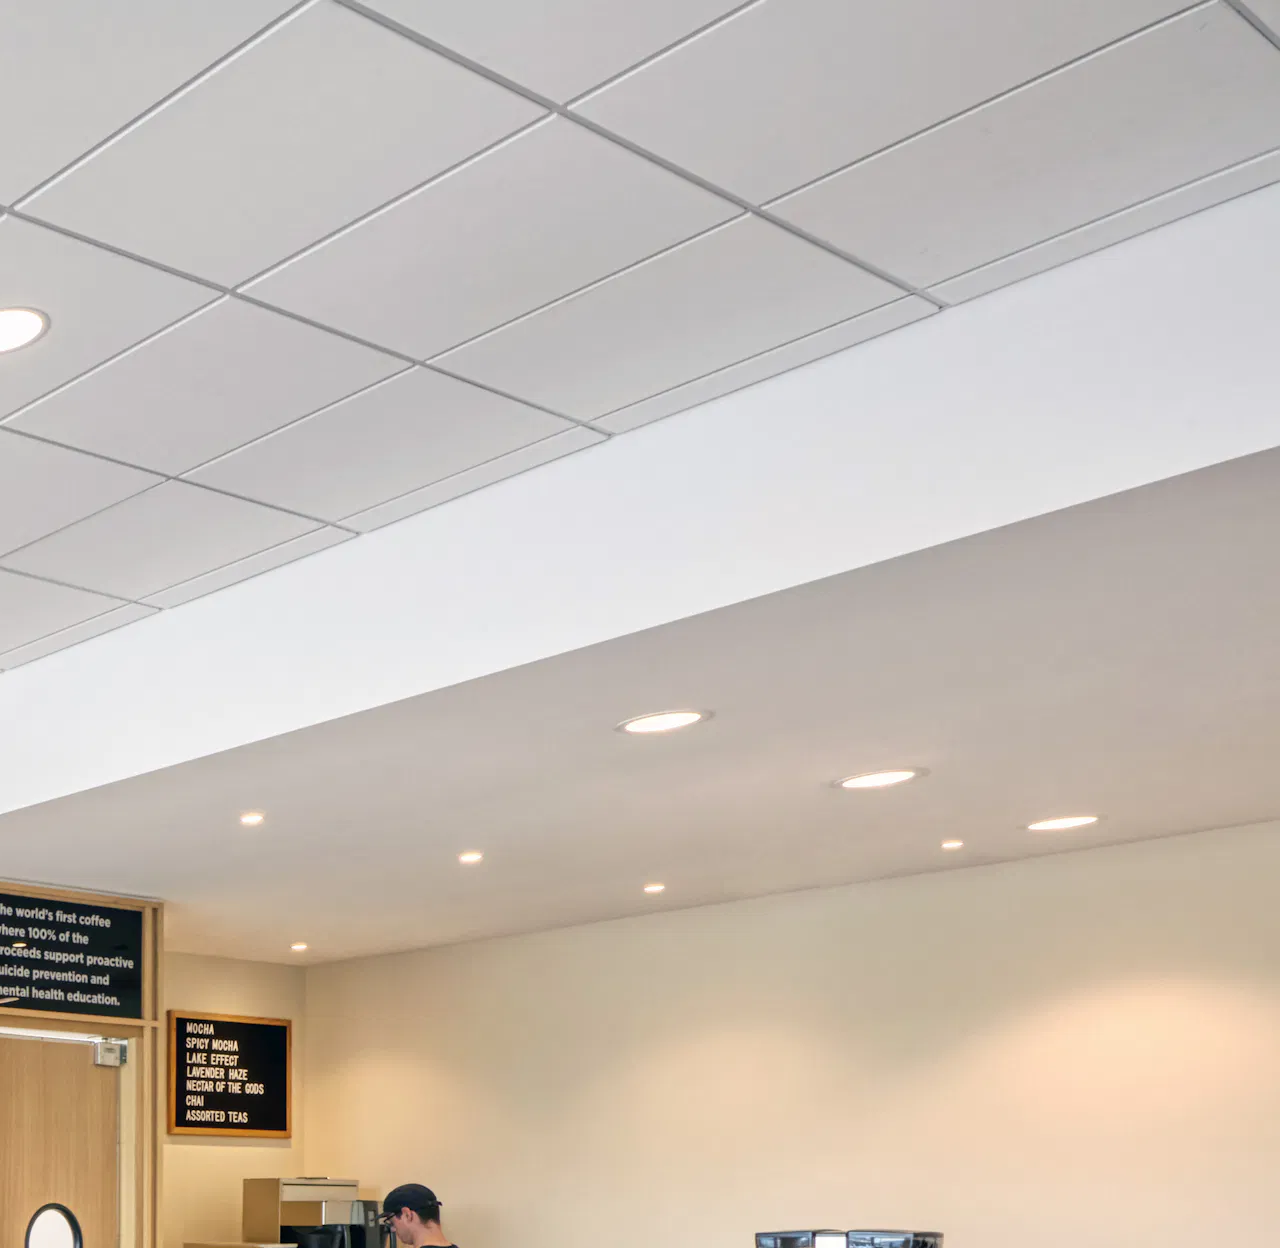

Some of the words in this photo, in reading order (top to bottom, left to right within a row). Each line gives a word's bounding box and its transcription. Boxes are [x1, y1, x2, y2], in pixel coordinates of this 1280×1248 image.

[15, 907, 53, 922] world's
[55, 910, 77, 924] first
[79, 915, 111, 928] coffee
[28, 927, 56, 941] 100%
[59, 931, 70, 942] of
[72, 932, 89, 945] the
[44, 950, 84, 964] support
[86, 955, 134, 969] proactive
[32, 969, 88, 983] prevention
[90, 974, 110, 986] and
[31, 986, 65, 1000] health
[66, 991, 120, 1006] education.
[186, 1022, 214, 1035] MOCHA
[186, 1037, 209, 1049] SPICY
[212, 1039, 238, 1051] MOCHA
[186, 1052, 207, 1064] LAKE
[211, 1053, 239, 1066] EFFECT
[186, 1066, 225, 1079] LAVENDER
[229, 1068, 248, 1081] HAZE
[186, 1080, 214, 1093] NECTAR
[215, 1081, 226, 1093] OF
[227, 1081, 242, 1094] THE
[245, 1083, 264, 1095] GODS
[186, 1095, 204, 1107] CHAI
[186, 1109, 226, 1123] ASSORTED
[228, 1111, 248, 1123] TEAS
